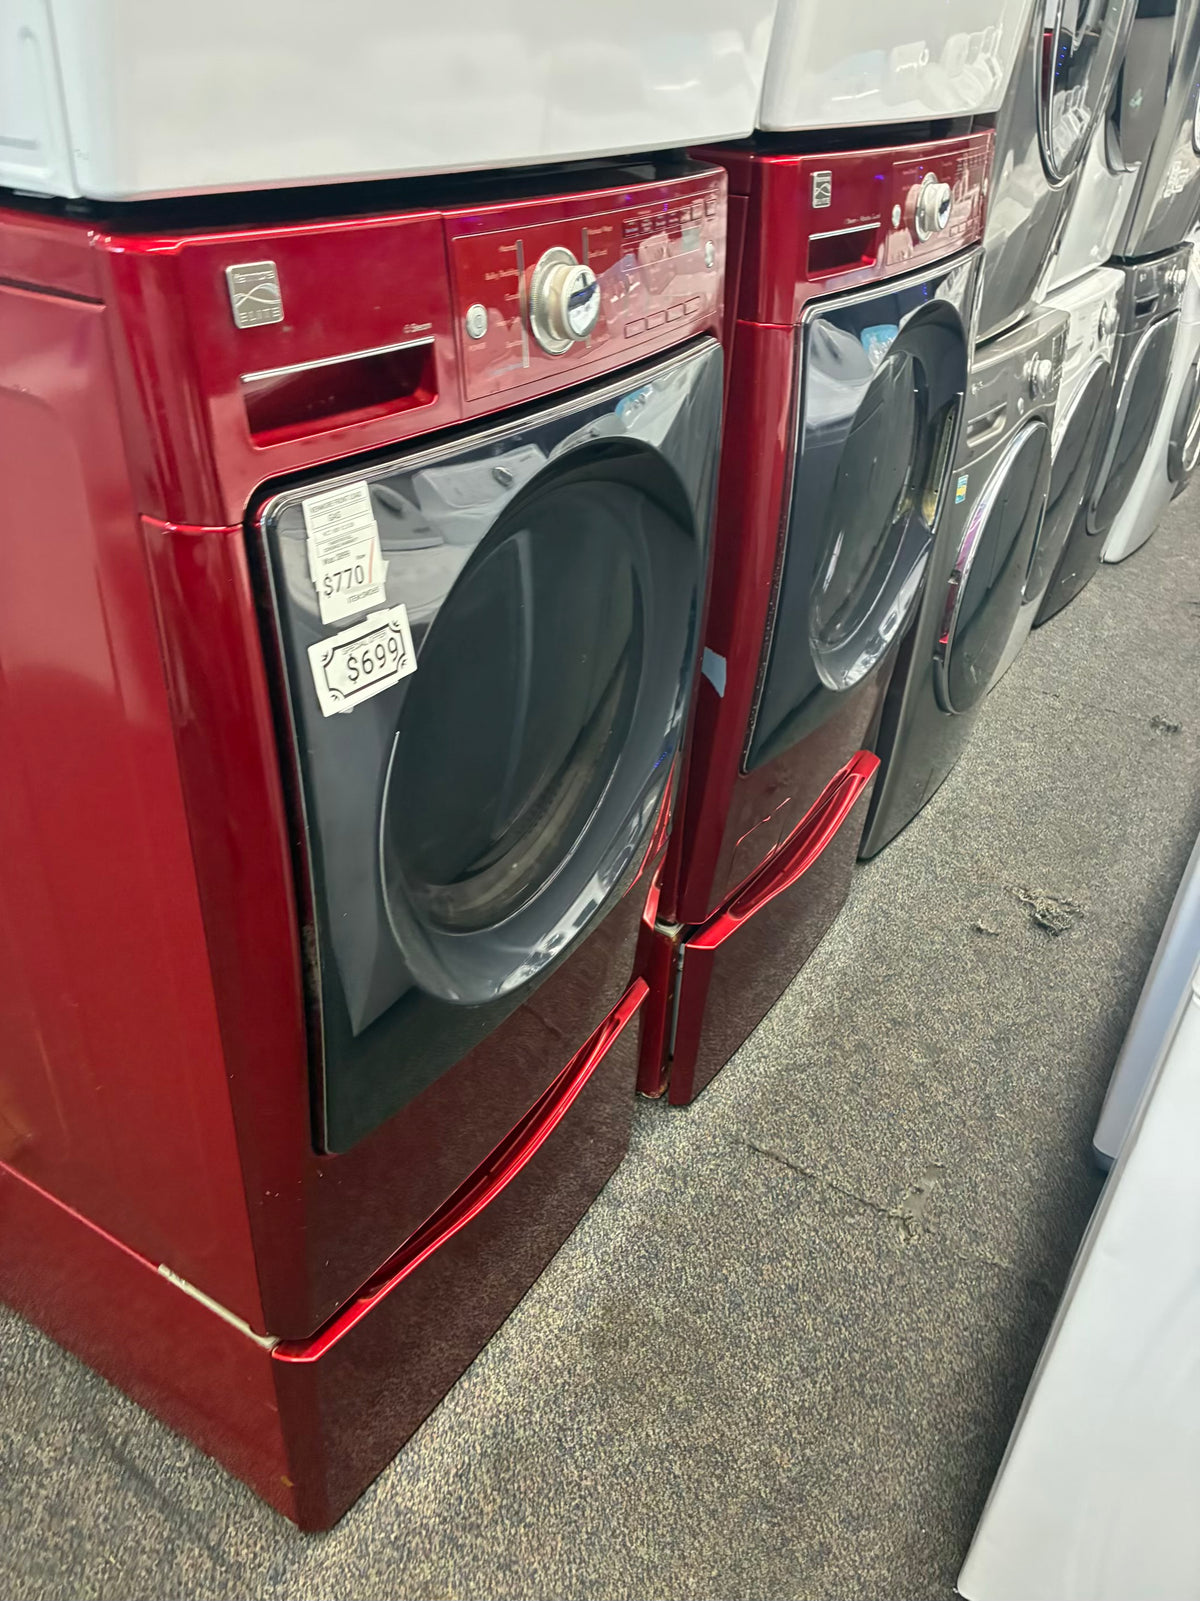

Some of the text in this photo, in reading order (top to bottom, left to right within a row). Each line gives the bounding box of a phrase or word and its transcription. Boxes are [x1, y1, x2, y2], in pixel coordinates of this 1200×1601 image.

[239, 307, 281, 323] ELITE
[323, 564, 365, 599] $770
[346, 636, 399, 685] $699
